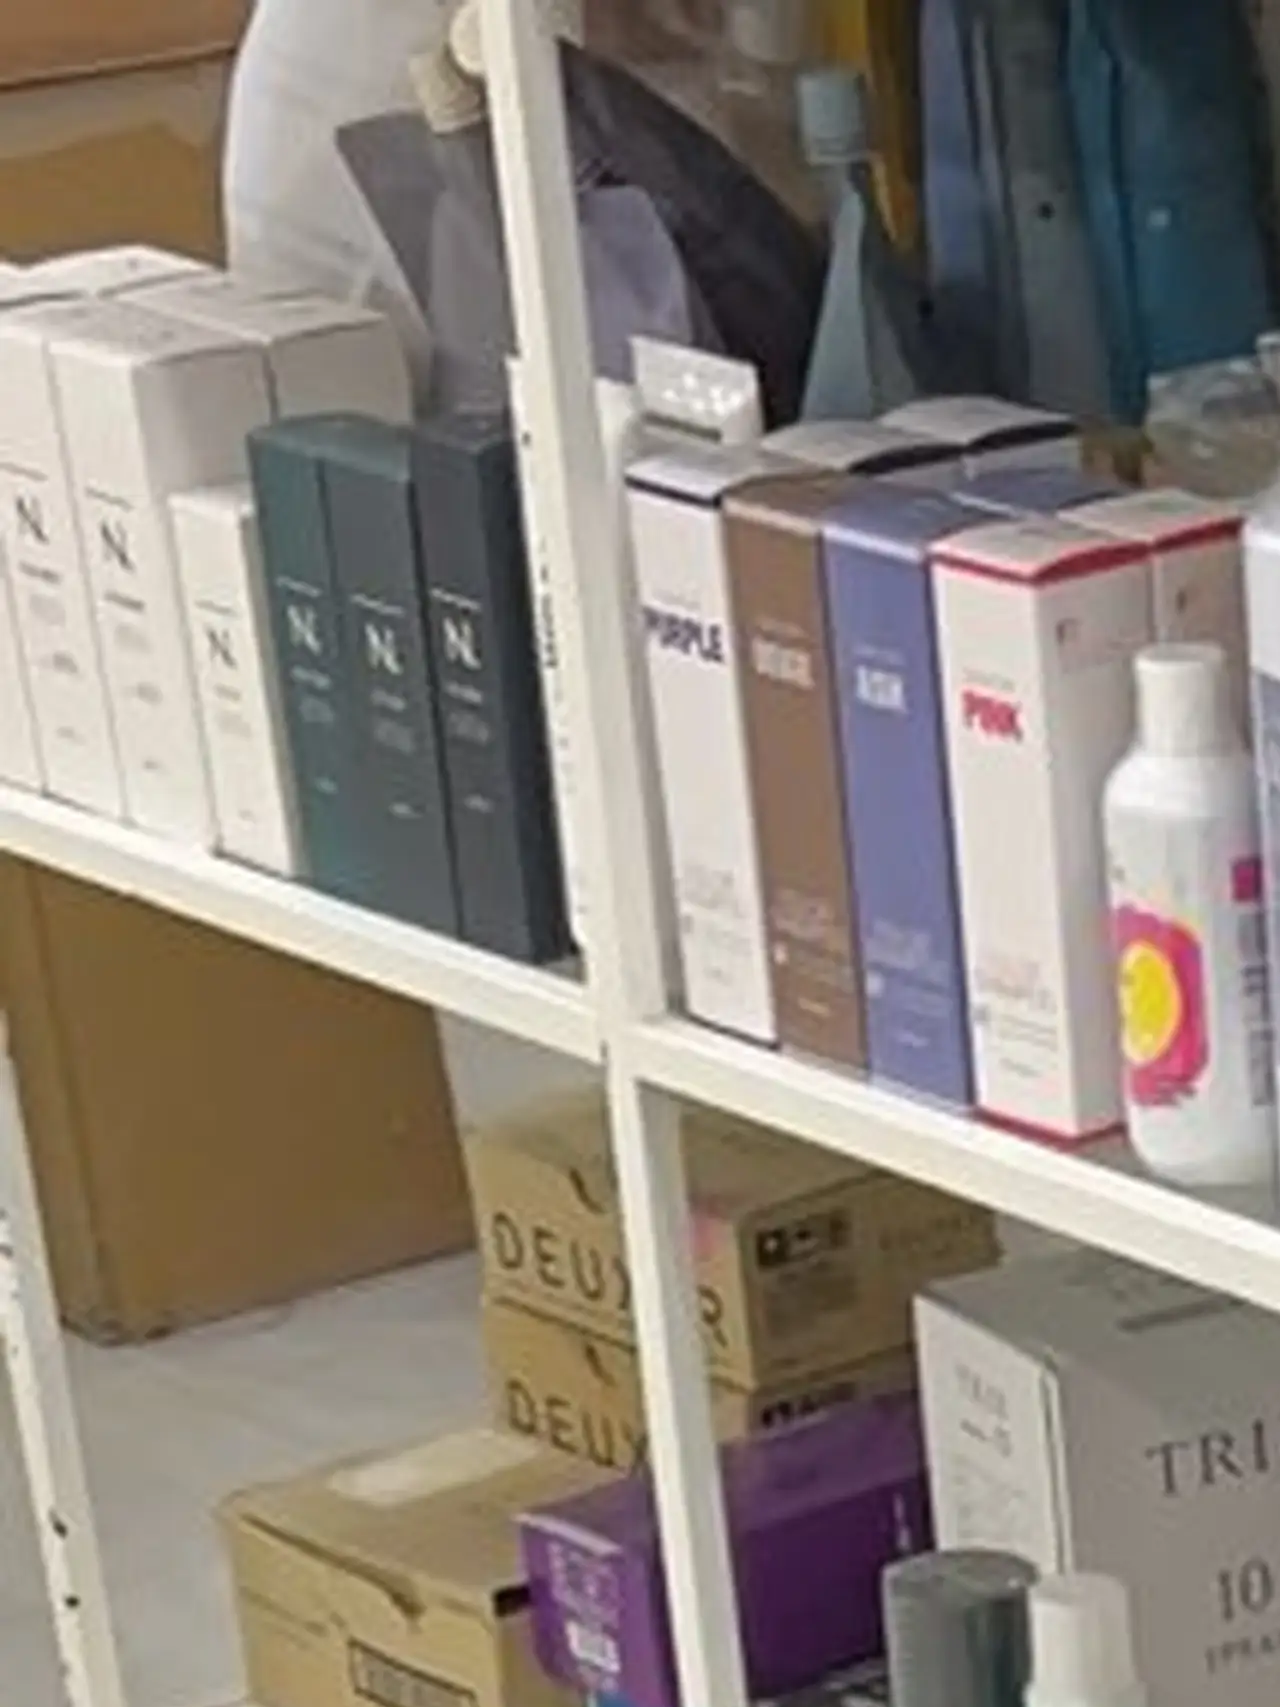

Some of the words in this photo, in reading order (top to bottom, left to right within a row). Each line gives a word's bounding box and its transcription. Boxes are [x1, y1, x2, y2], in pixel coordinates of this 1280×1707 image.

[641, 603, 726, 663] PURPLE
[960, 688, 1023, 741] PINK
[1218, 1556, 1273, 1622] 10
